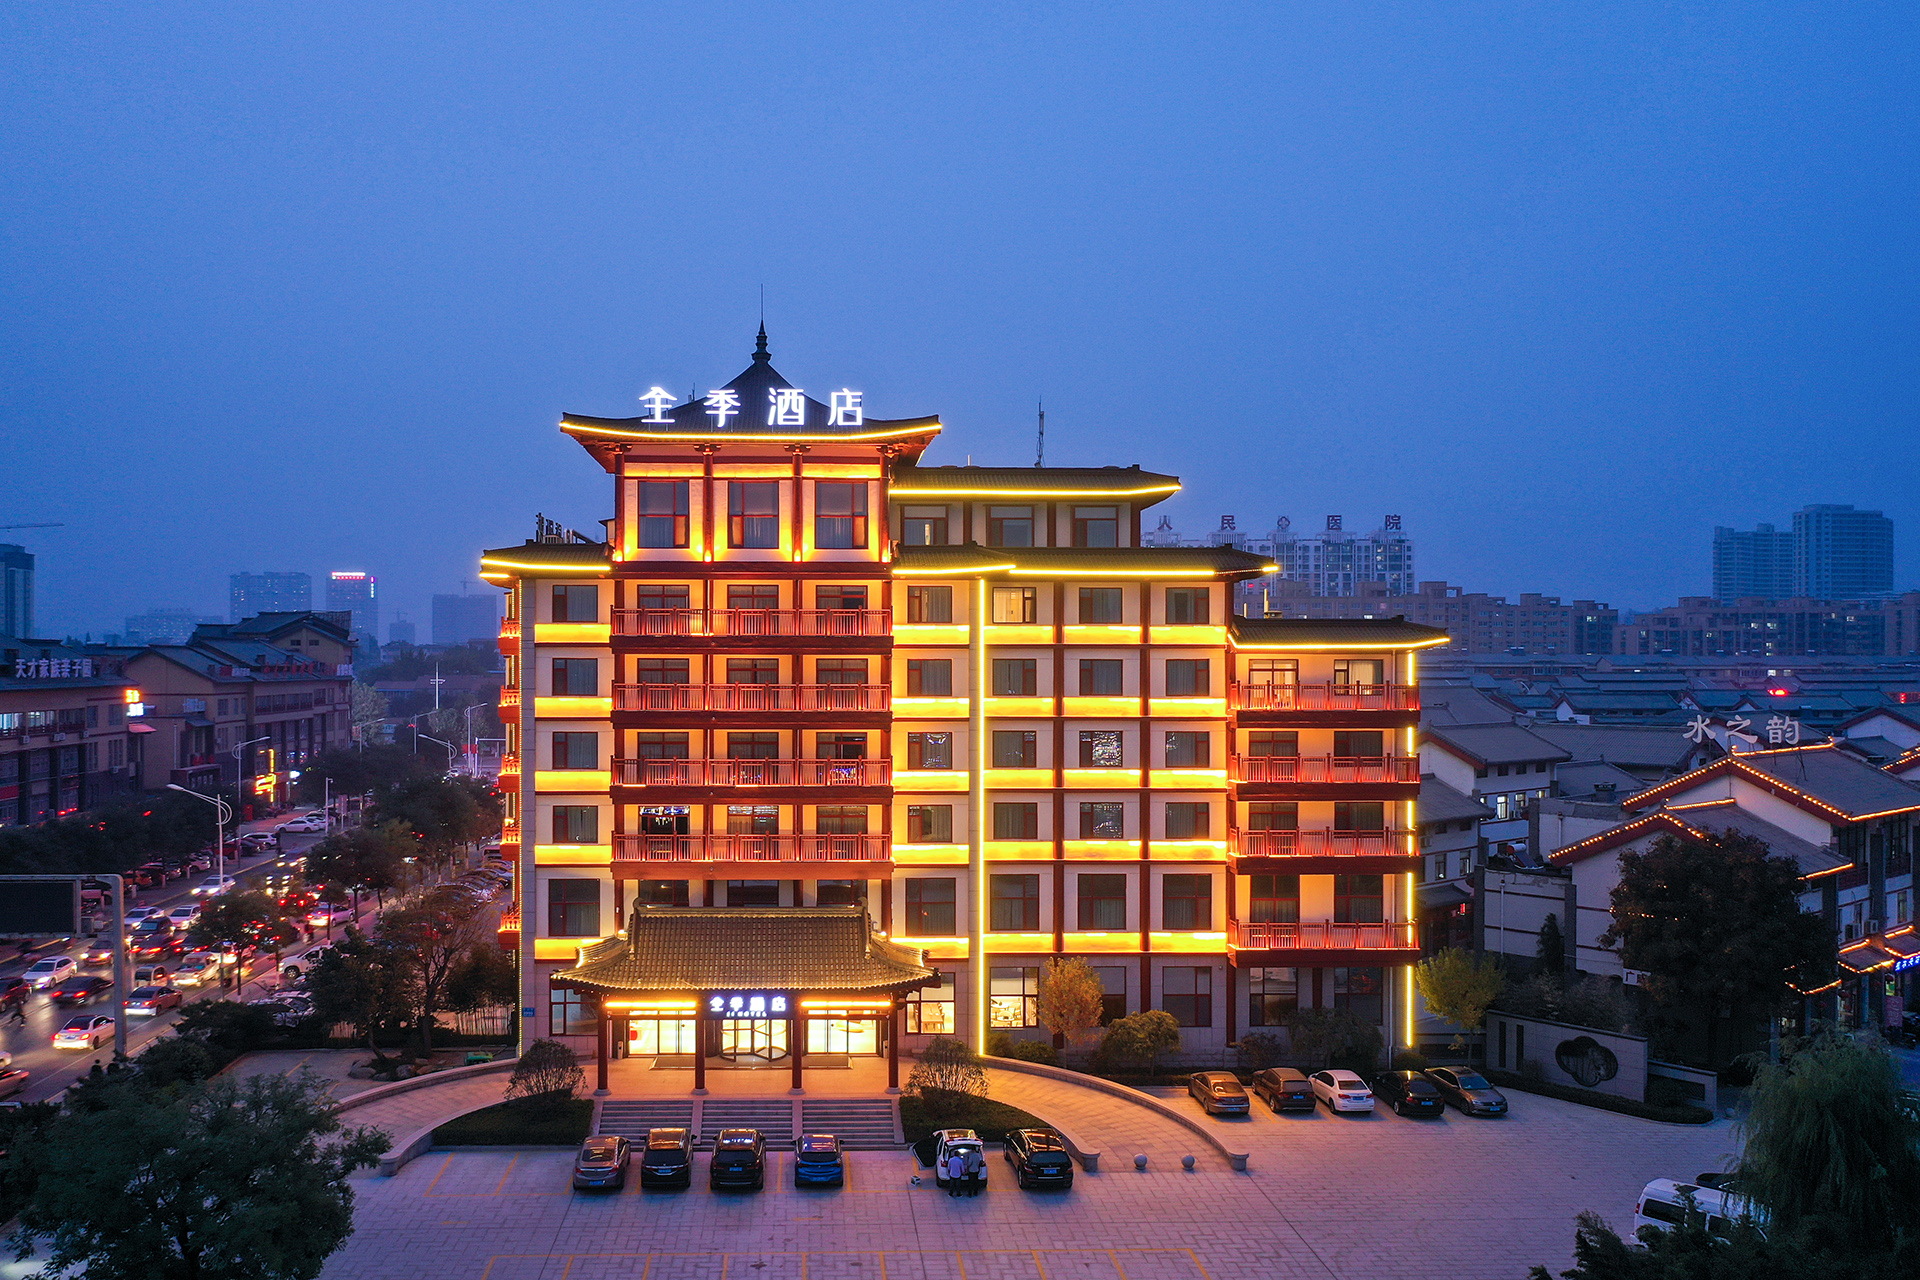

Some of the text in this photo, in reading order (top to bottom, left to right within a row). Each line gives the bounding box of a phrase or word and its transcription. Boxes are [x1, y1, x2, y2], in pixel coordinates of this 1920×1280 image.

[639, 387, 864, 428] 全季酒店
[1157, 514, 1402, 531] 人民医院
[1682, 714, 1800, 745] 水之韵
[709, 996, 786, 1012] 全季酒店
